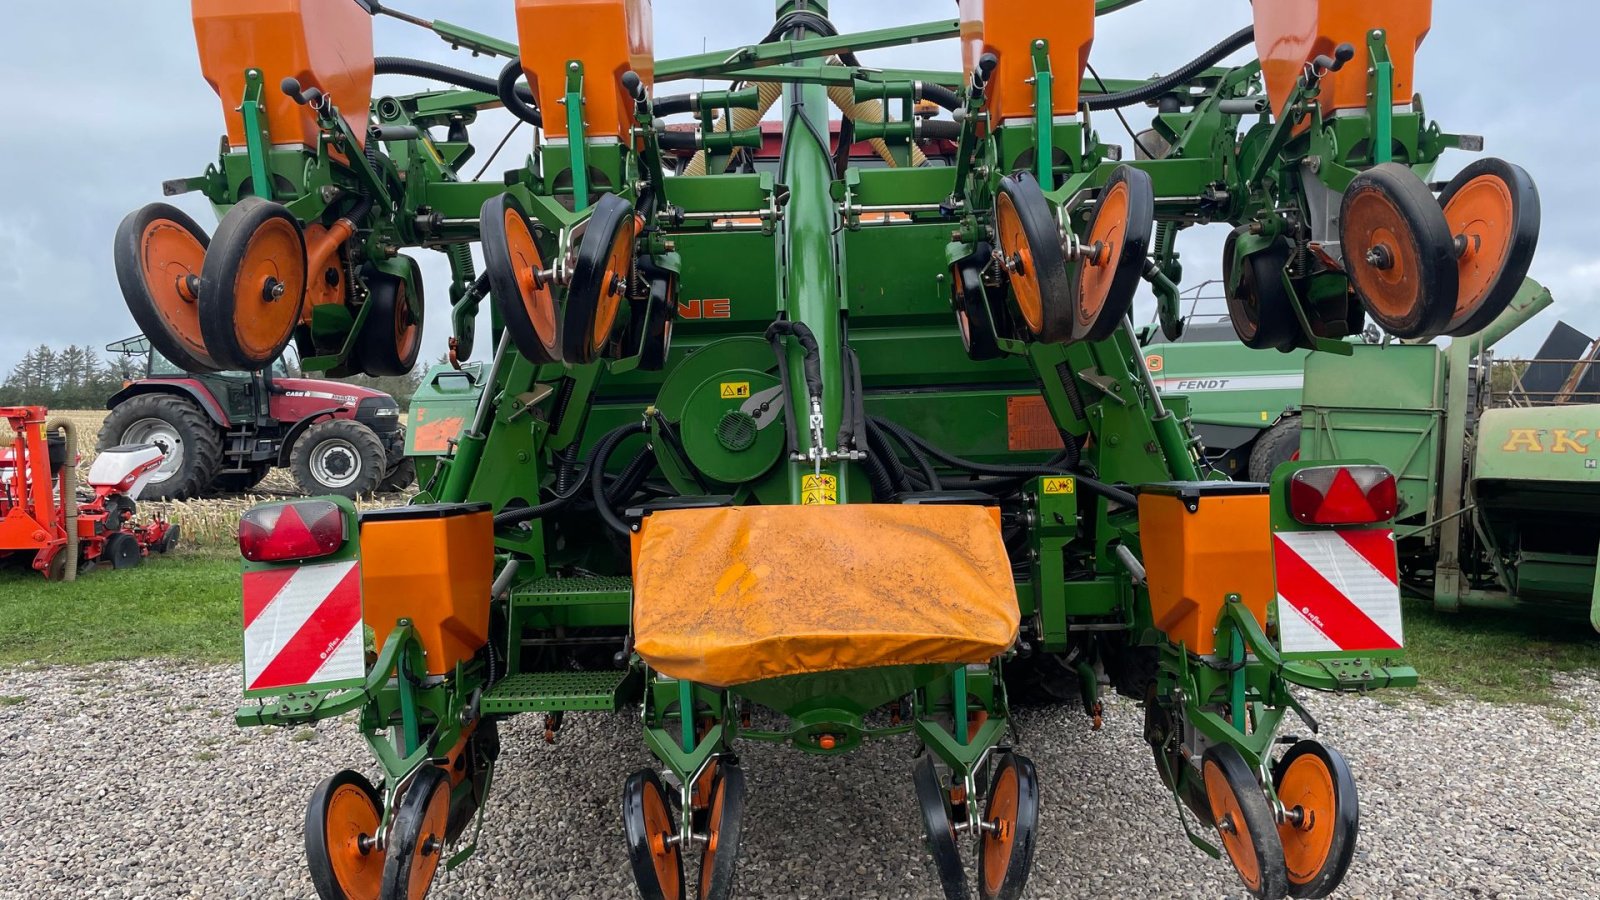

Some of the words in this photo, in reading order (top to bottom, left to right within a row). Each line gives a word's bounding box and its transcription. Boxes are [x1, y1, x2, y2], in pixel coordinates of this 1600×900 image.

[1177, 379, 1229, 390] FENDT
[1502, 427, 1600, 454] AK
[1307, 612, 1324, 628] reflex
[325, 637, 340, 654] reflex
